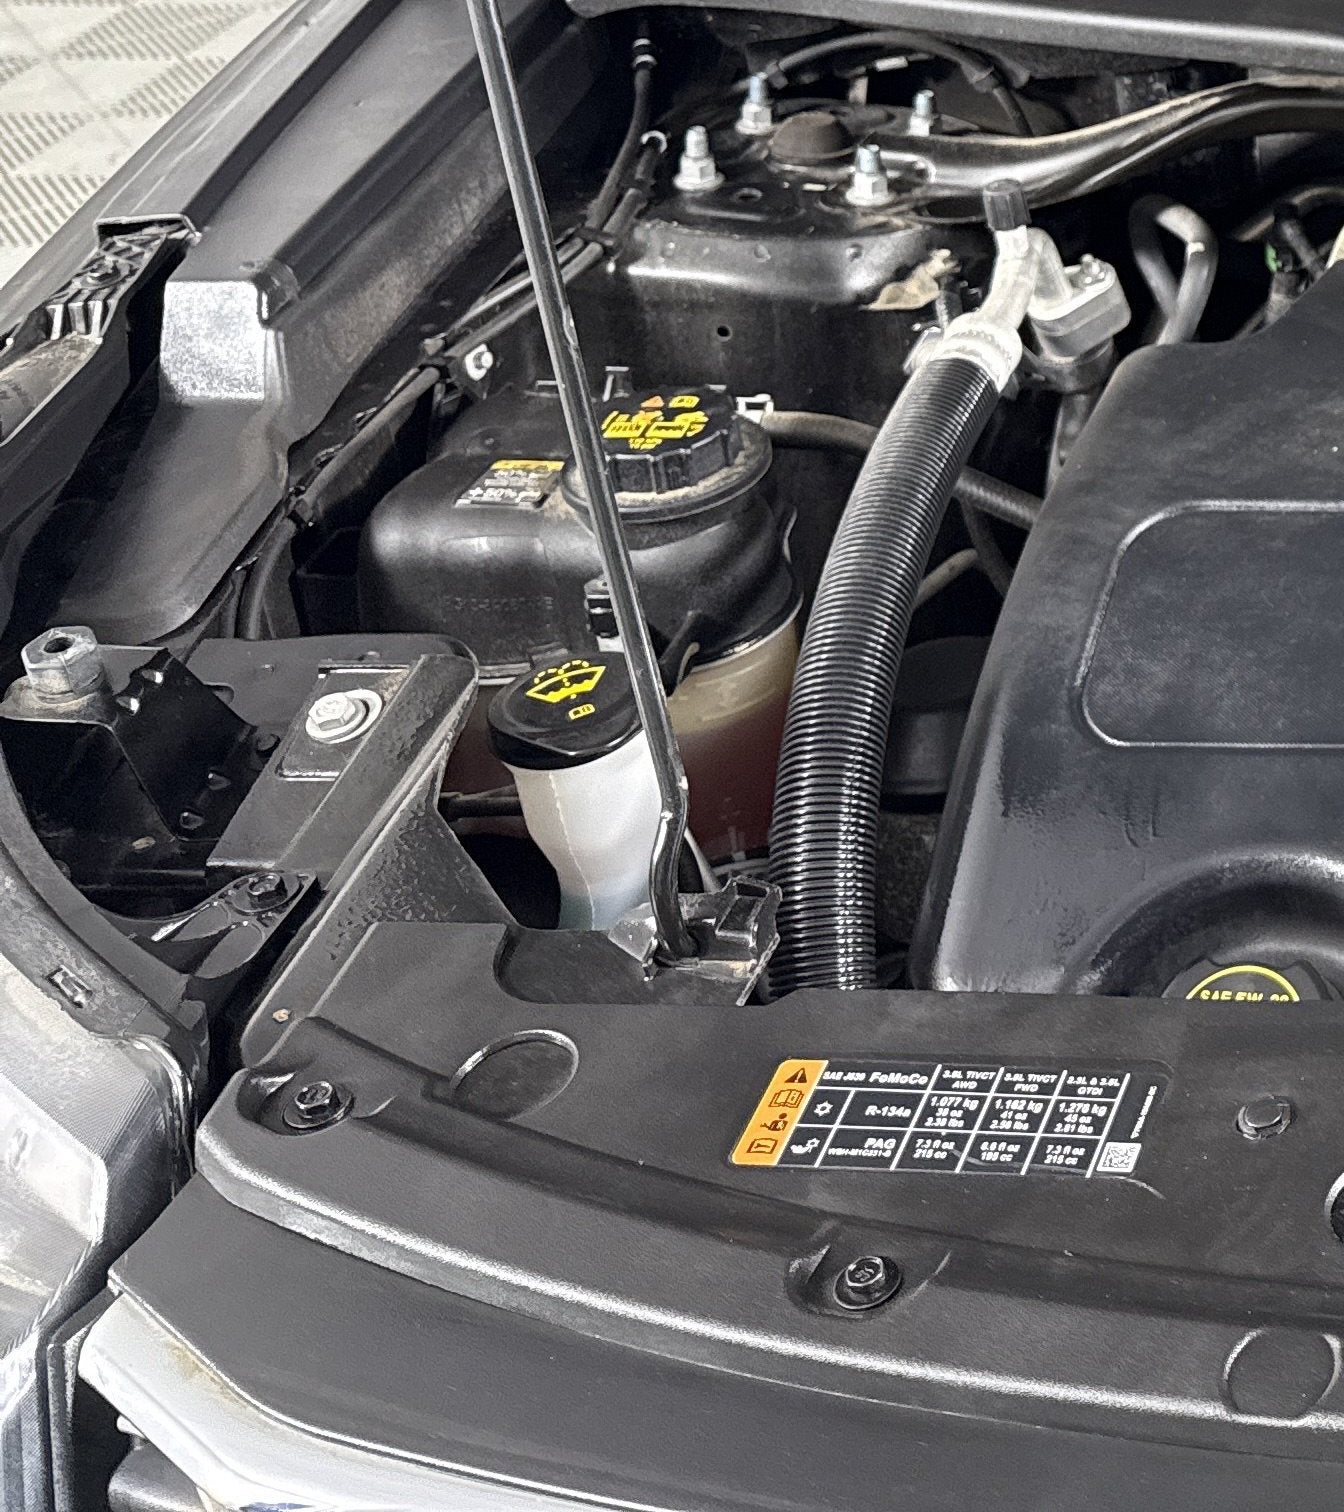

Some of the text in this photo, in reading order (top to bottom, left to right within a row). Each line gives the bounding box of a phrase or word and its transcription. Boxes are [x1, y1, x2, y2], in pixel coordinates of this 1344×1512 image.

[1200, 989, 1233, 1001] SAE
[868, 1071, 929, 1085] FoMoCo
[951, 1080, 978, 1090] AWD
[1013, 1083, 1039, 1093] FWD
[930, 1095, 980, 1111] 1.077 kg
[1027, 1100, 1044, 1114] kg
[864, 1104, 912, 1118] R-134a
[949, 1109, 964, 1118] oz
[999, 1110, 1029, 1121] 41 oz
[1090, 1103, 1108, 1117] kg
[947, 1117, 965, 1128] lbs
[1078, 1115, 1093, 1124] oz
[1012, 1120, 1030, 1131] lbs
[1077, 1123, 1094, 1134] lbs
[863, 1137, 897, 1149] PAG
[915, 1138, 933, 1149] 7.3
[941, 1141, 956, 1150] oz
[1006, 1143, 1021, 1152] oz
[934, 1150, 948, 1159] cc
[1045, 1144, 1063, 1154] 7.3
[1071, 1147, 1086, 1156] oz
[999, 1153, 1014, 1162] cc
[1064, 1156, 1079, 1166] cc
